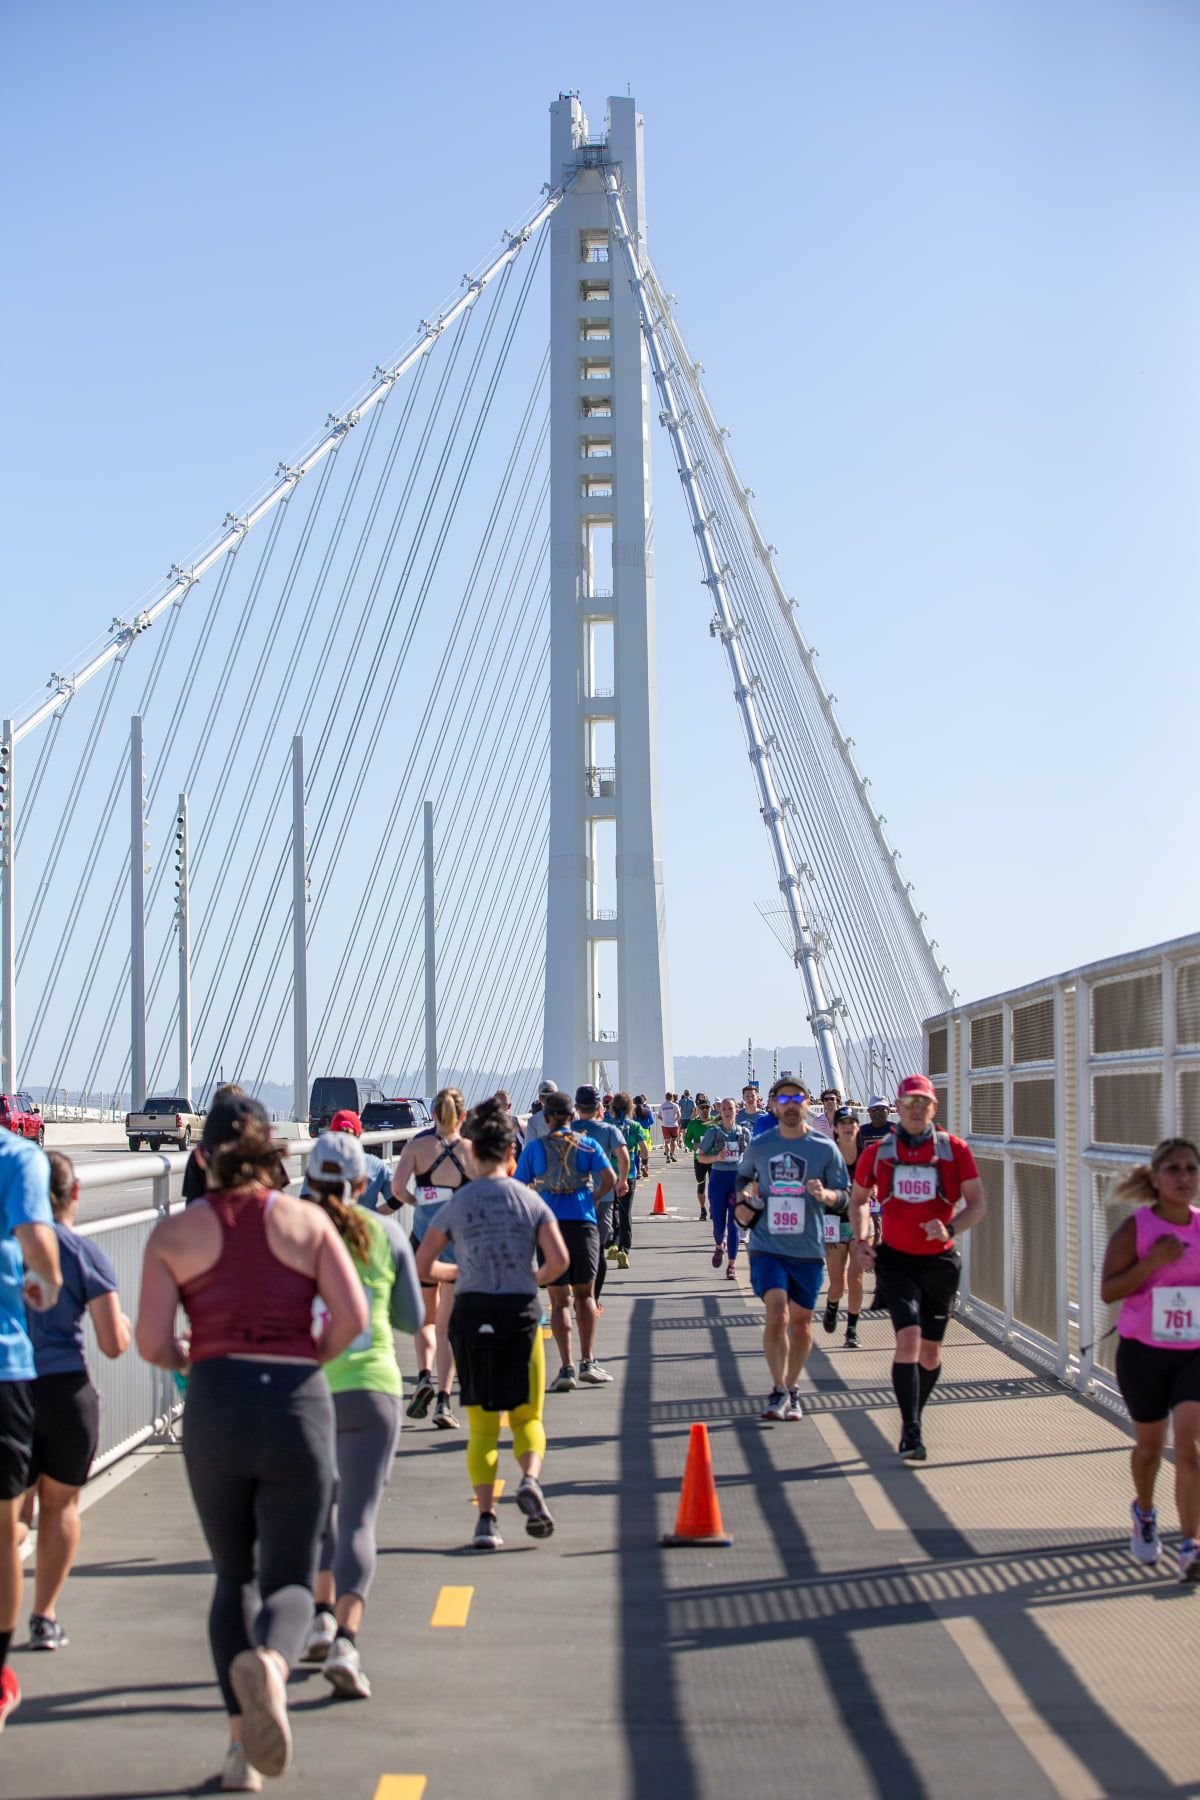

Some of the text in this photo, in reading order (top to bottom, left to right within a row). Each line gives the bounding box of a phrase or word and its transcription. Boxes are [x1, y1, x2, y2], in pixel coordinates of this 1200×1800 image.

[897, 1180, 931, 1195] 1066
[773, 1212, 798, 1226] 396
[1163, 1310, 1192, 1328] 761
